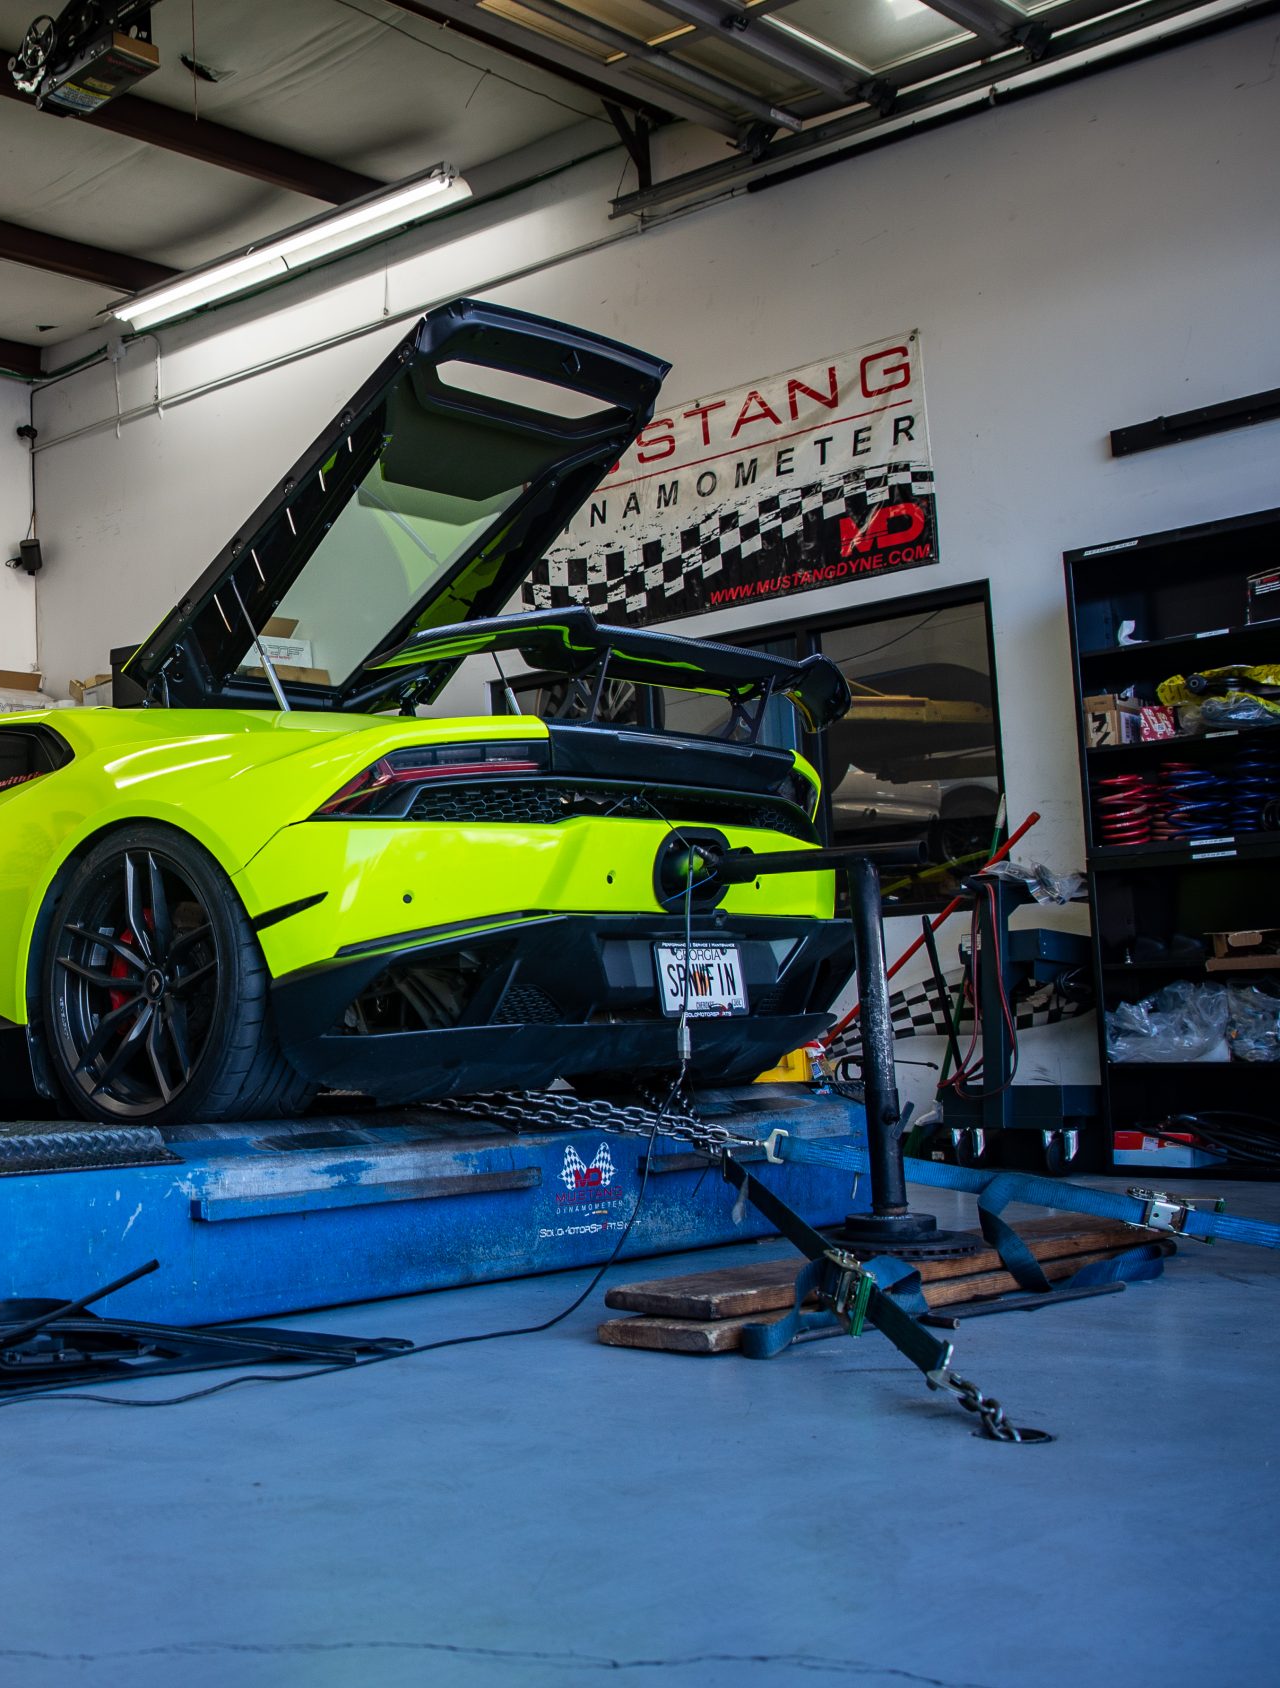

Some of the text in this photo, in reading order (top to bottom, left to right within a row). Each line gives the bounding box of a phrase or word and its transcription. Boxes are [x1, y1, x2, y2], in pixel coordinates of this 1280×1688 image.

[607, 345, 913, 475] STANG
[564, 415, 916, 534] NAMOMETER
[709, 544, 932, 605] WWW.MUSTANGDYNE.COM
[556, 1185, 623, 1204] MUSTANG
